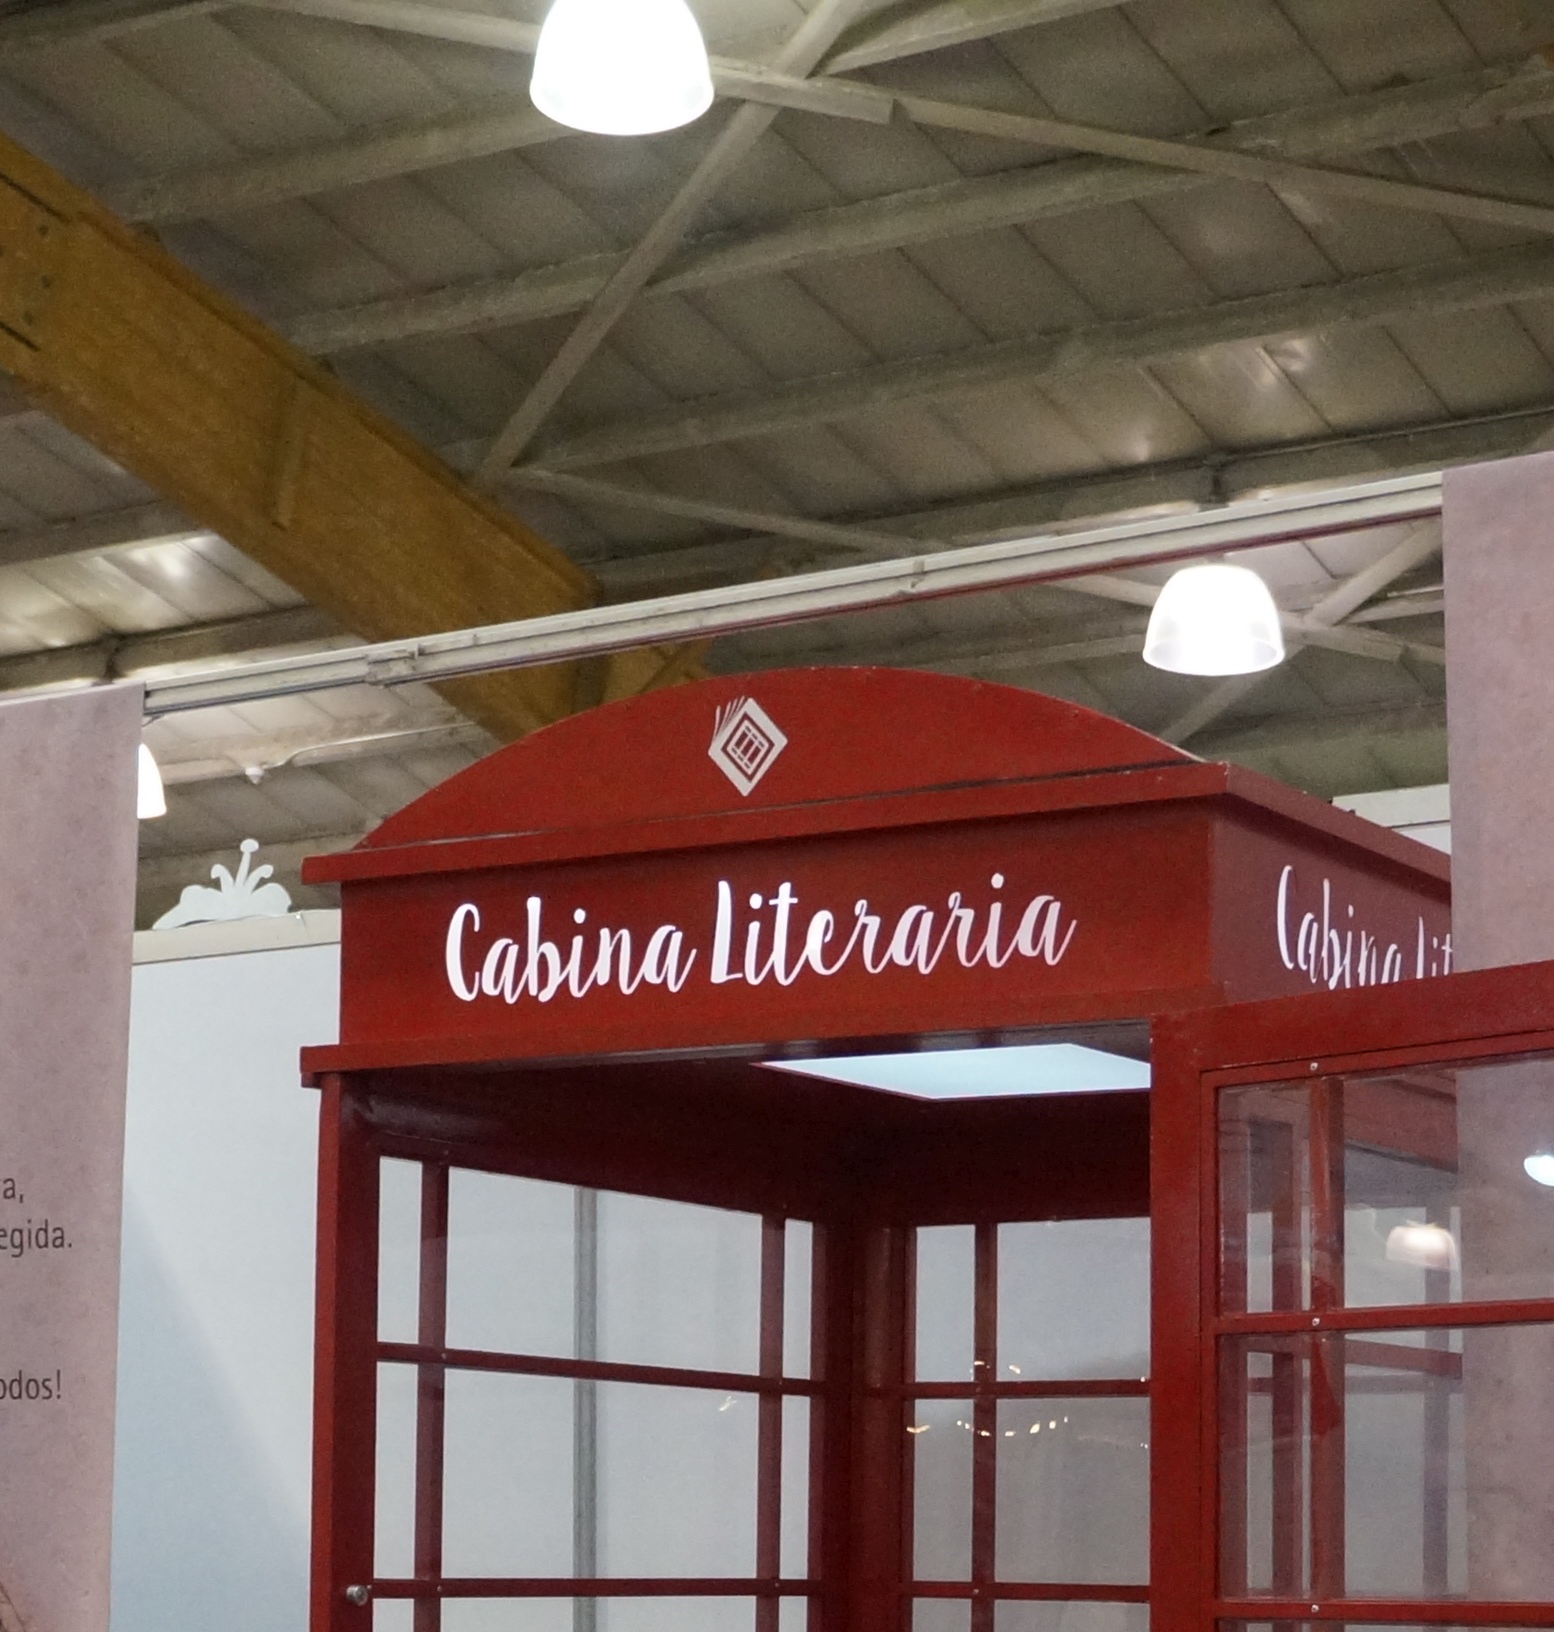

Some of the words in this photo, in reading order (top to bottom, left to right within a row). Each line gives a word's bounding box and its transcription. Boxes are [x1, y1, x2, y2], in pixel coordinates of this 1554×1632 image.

[445, 895, 698, 1004] Cabina
[709, 872, 1078, 986] Literaria
[1276, 864, 1403, 991] Cabina
